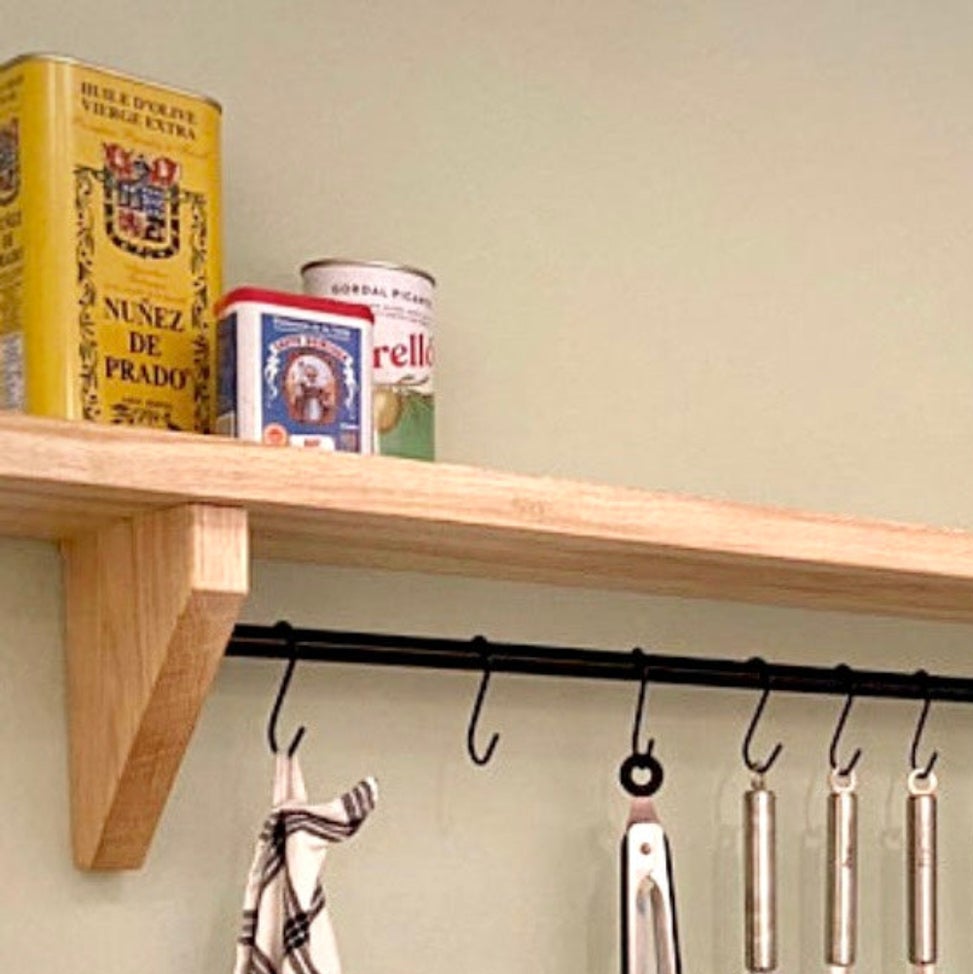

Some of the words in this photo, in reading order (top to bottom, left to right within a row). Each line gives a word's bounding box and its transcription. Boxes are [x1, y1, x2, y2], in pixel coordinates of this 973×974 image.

[80, 98, 139, 125] VIERGE
[145, 115, 196, 140] EXTRA
[81, 82, 130, 107] HUILE
[133, 96, 197, 125] D'OLIVE
[331, 284, 388, 299] GORDAL
[129, 331, 162, 357] DE
[105, 356, 188, 391] PRADO
